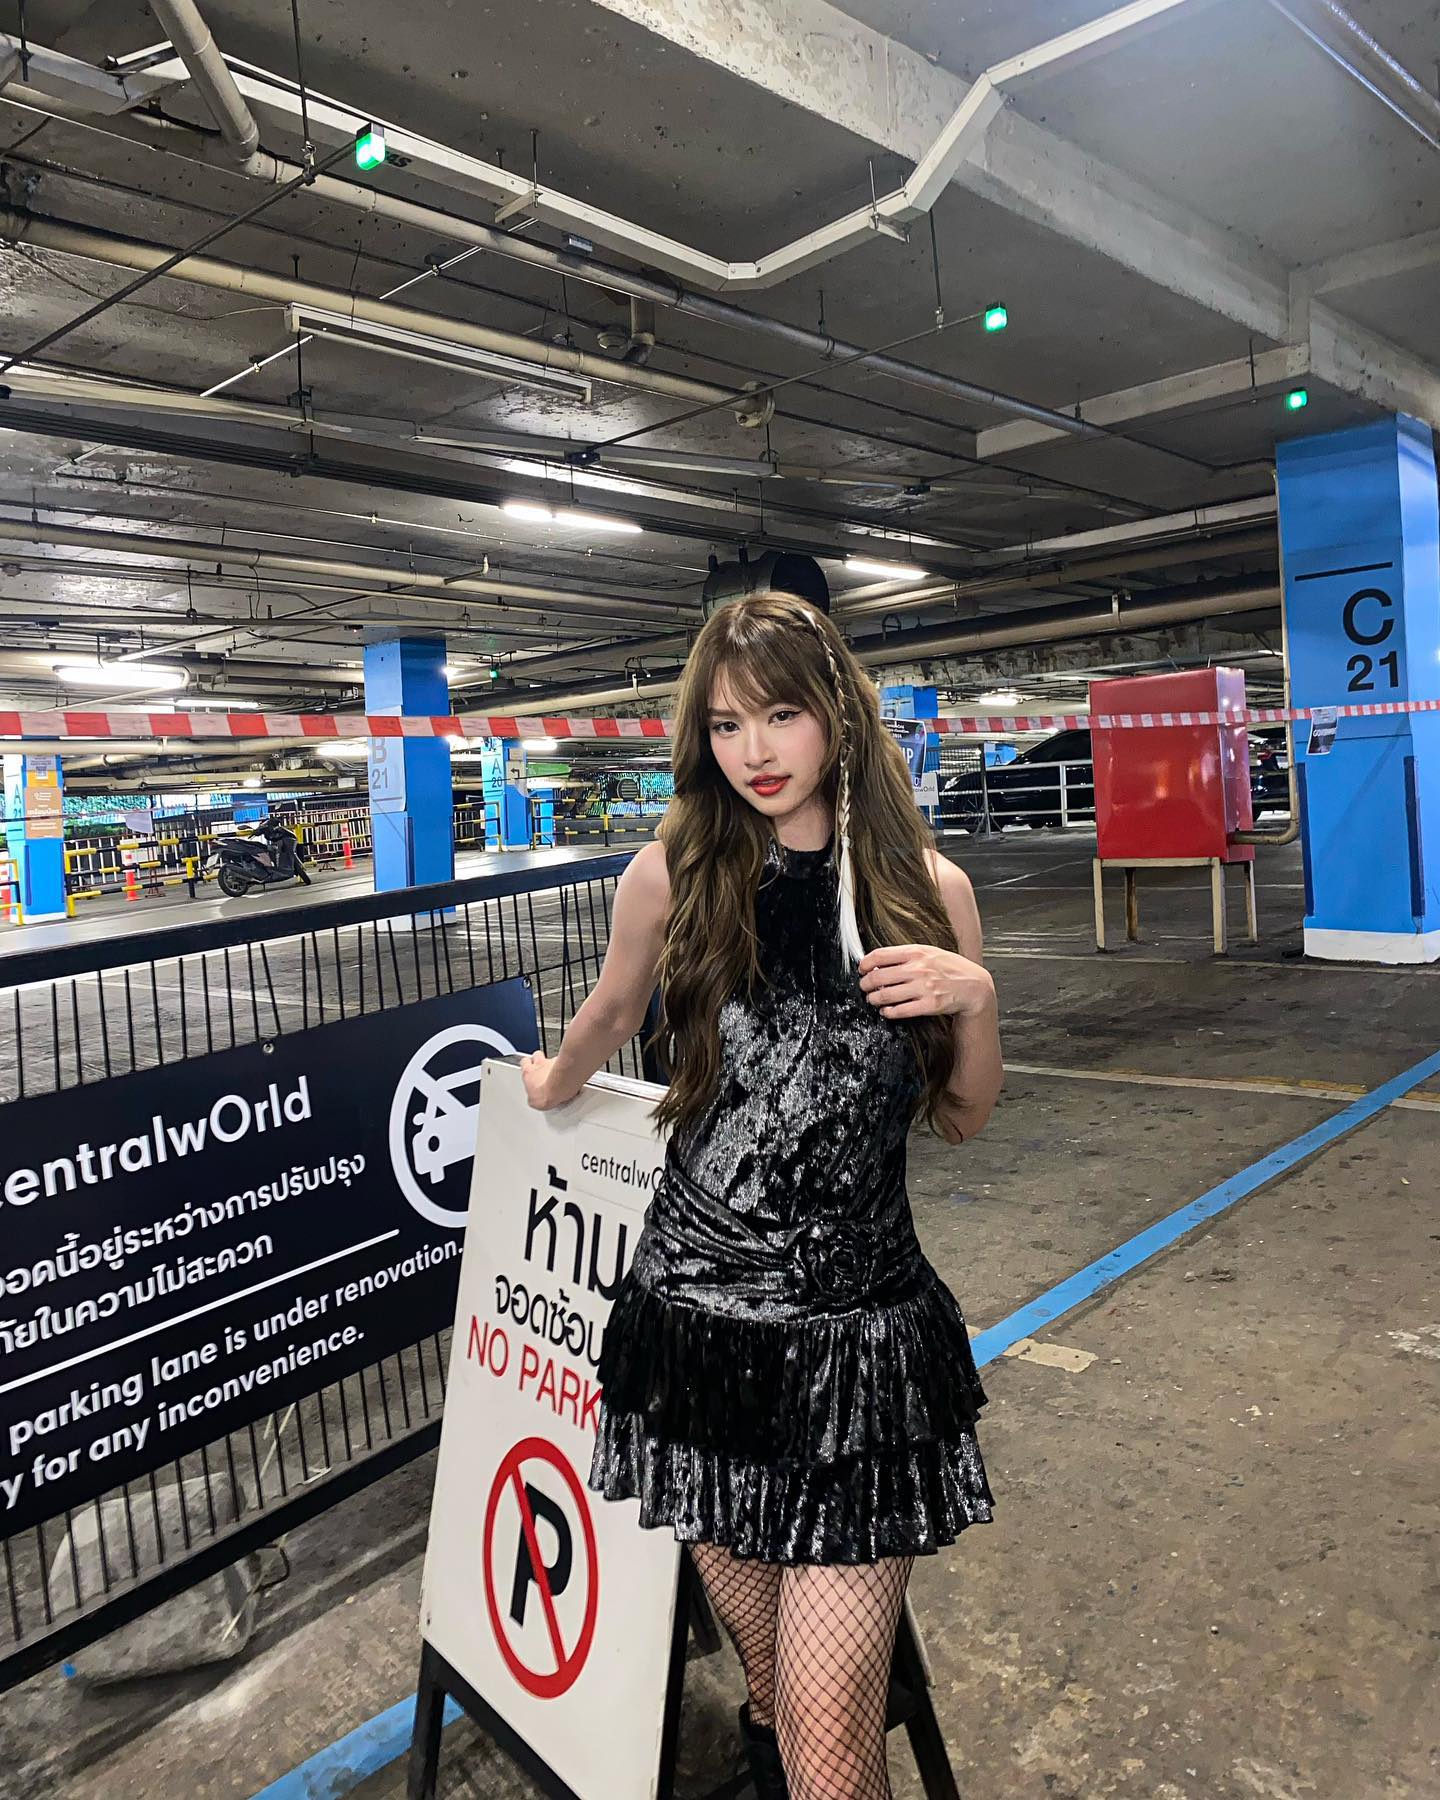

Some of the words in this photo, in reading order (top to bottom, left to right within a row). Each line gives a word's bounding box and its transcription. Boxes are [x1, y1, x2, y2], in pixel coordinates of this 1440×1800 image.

[1342, 588, 1395, 646] C
[1346, 650, 1399, 693] 21
[372, 737, 387, 764] B
[492, 758, 502, 775] A
[13, 784, 22, 804] A
[372, 767, 388, 790] 21
[491, 776, 503, 788] 20
[0, 1075, 313, 1209] entralwOrld
[524, 1164, 627, 1301] ห้าม
[9, 1373, 144, 1456] parking
[151, 1342, 218, 1387] lane
[224, 1326, 248, 1355] is
[253, 1294, 329, 1341] under
[335, 1240, 463, 1306] renovation.
[467, 1314, 510, 1377] NO
[32, 1448, 82, 1488] for
[89, 1417, 151, 1462] any
[158, 1325, 365, 1431] inconvenience.
